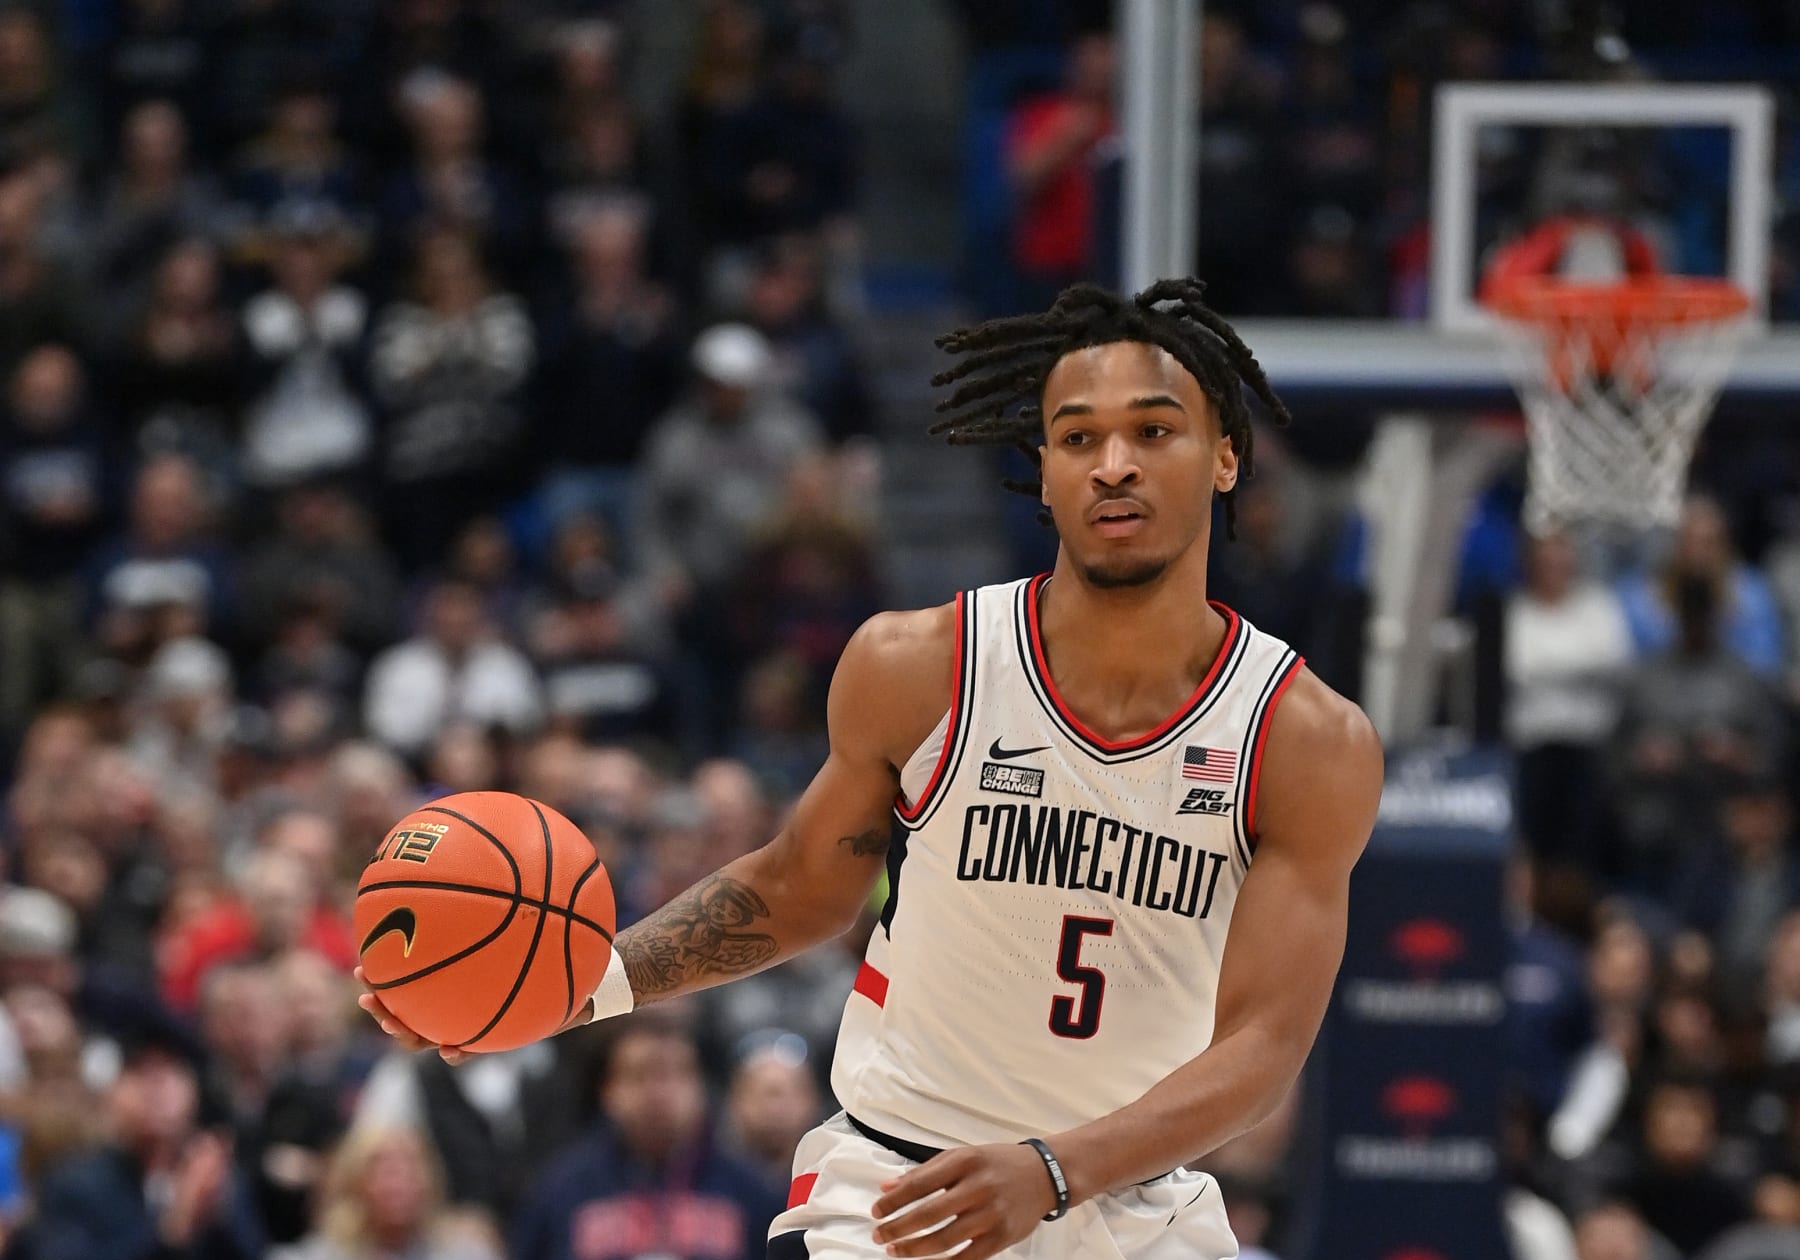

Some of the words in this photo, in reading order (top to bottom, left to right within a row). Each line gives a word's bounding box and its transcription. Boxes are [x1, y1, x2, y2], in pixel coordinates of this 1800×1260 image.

[982, 779, 1040, 796] CHANGE
[1186, 788, 1226, 801] BIG
[1180, 799, 1235, 813] EAST
[957, 804, 1228, 919] CONNECTICUT
[1049, 915, 1114, 1039] 5
